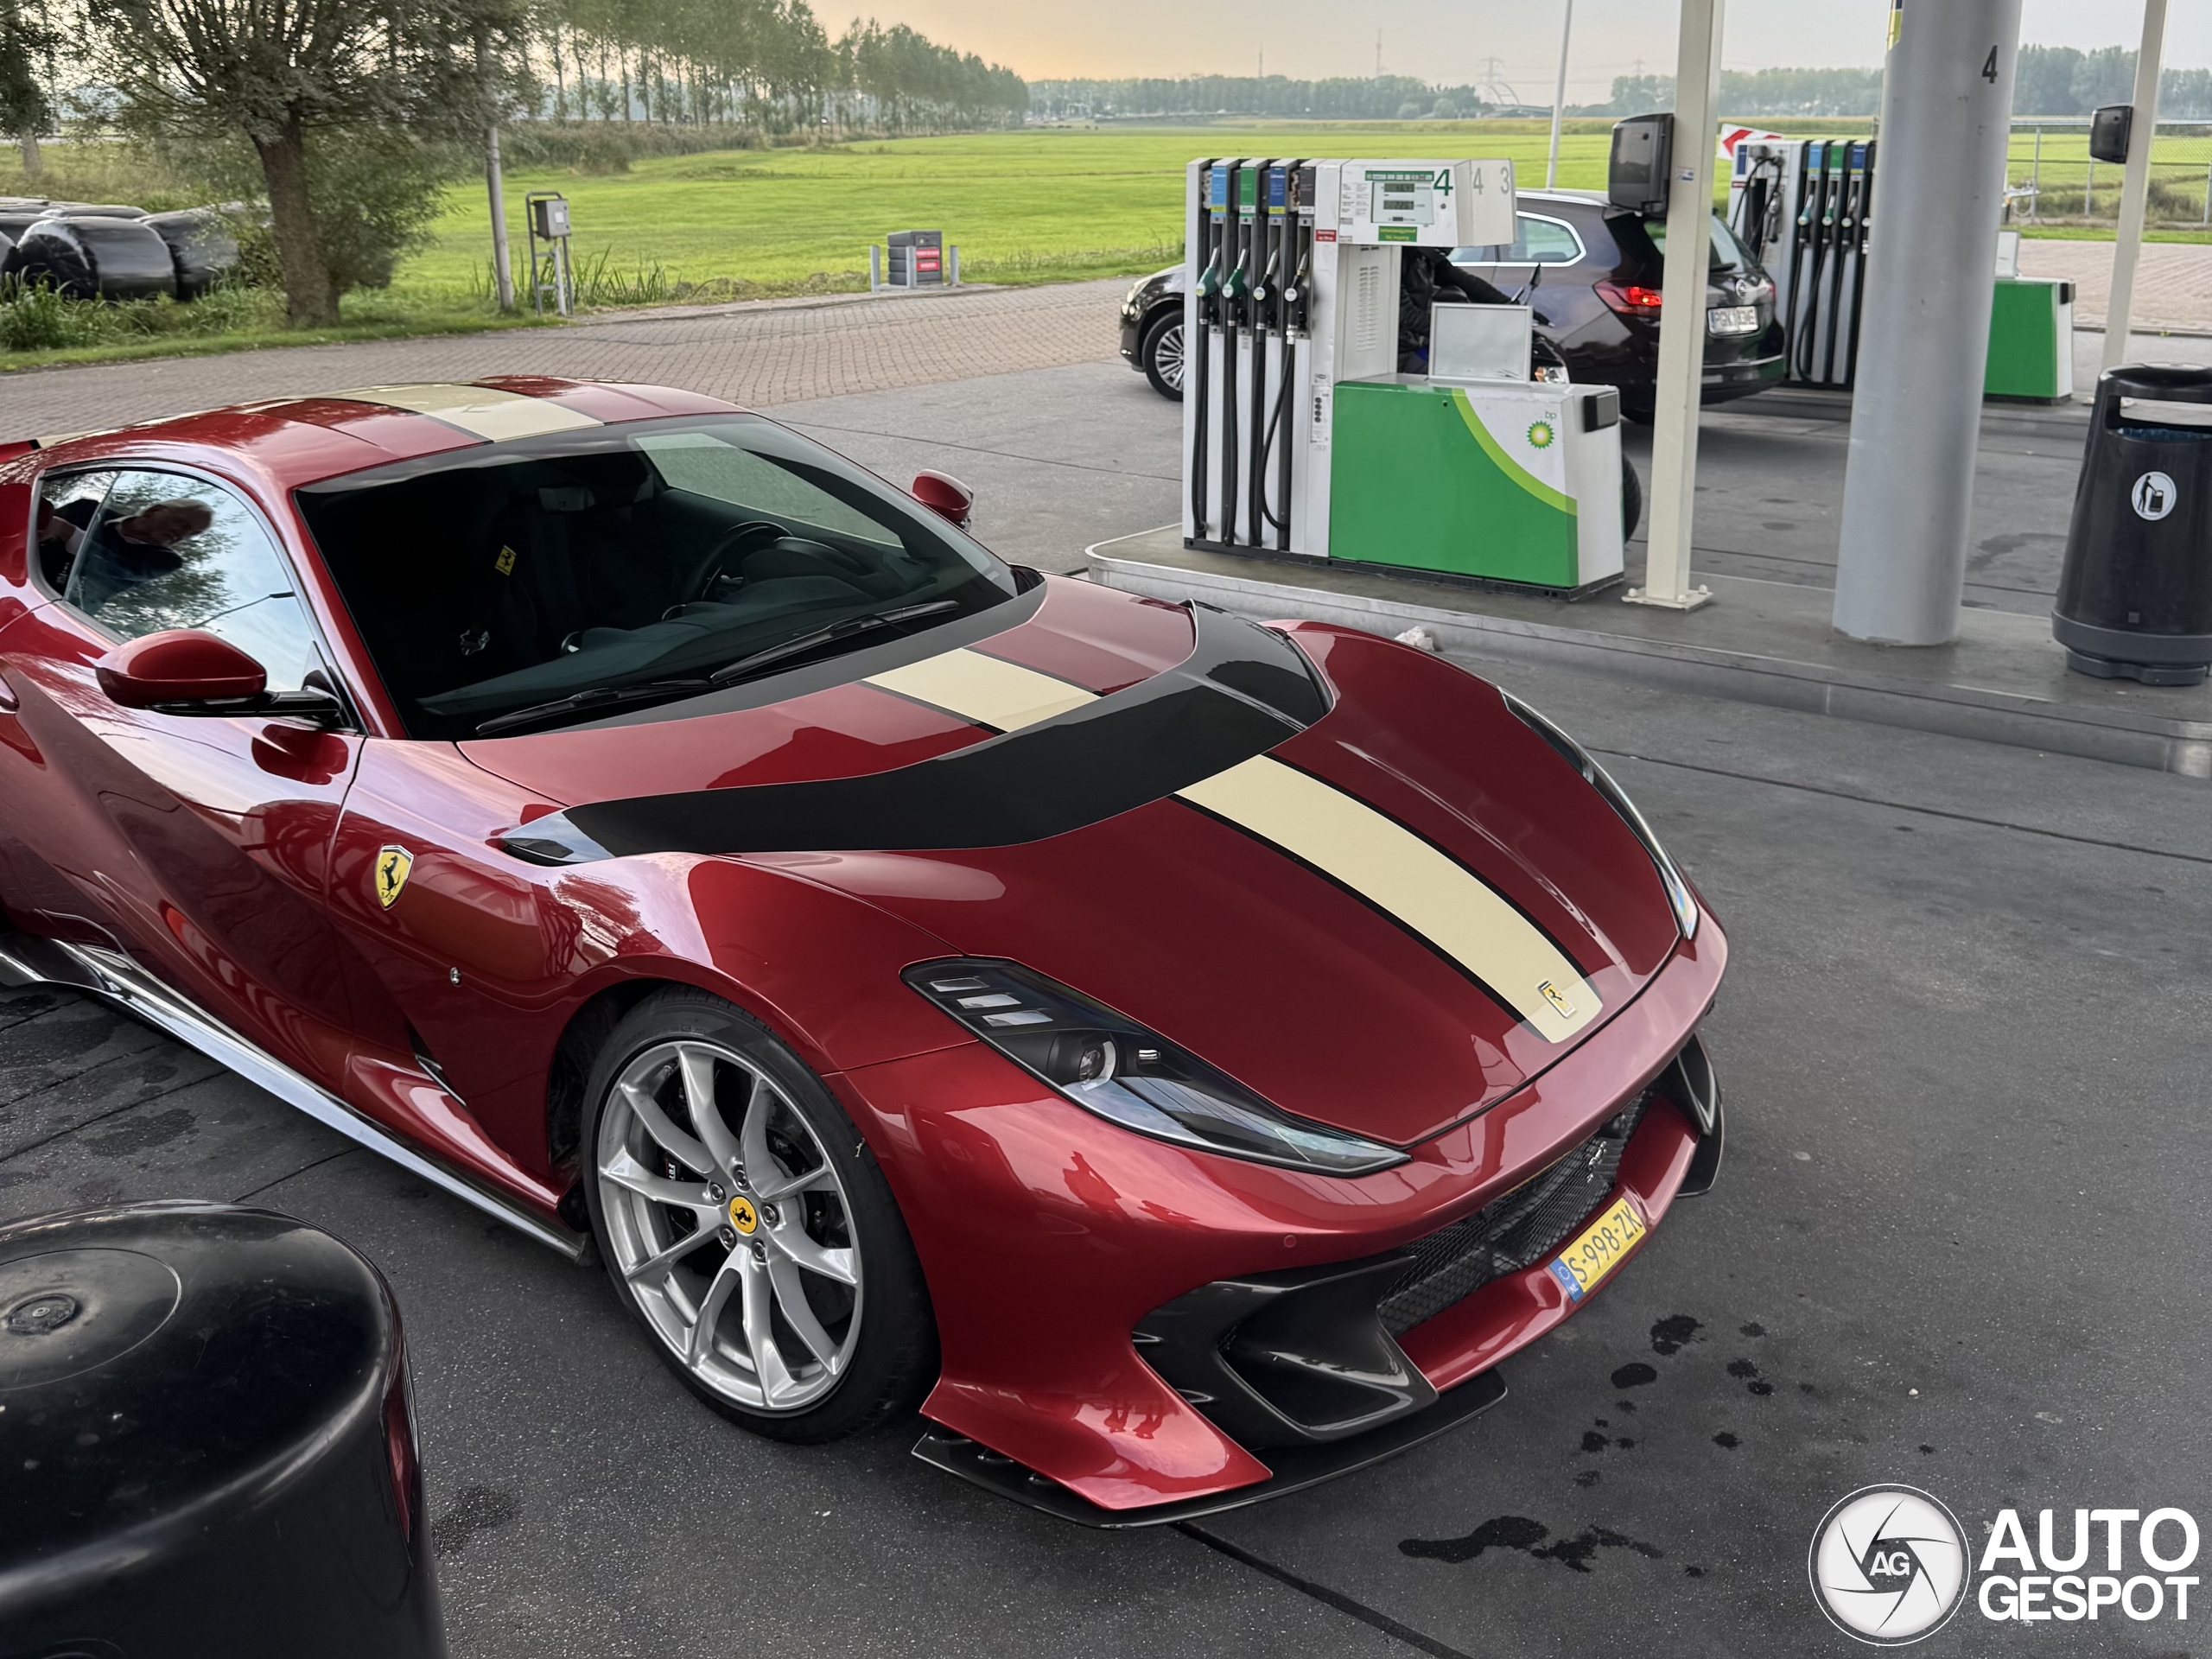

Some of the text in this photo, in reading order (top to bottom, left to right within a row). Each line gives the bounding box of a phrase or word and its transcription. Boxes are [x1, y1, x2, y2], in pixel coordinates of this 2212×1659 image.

[1982, 45, 1998, 83] 4
[1433, 168, 1453, 196] 4
[1473, 166, 1510, 195] 4 3
[1545, 410, 1557, 420] bp
[1567, 1205, 1643, 1283] S-998-ZK
